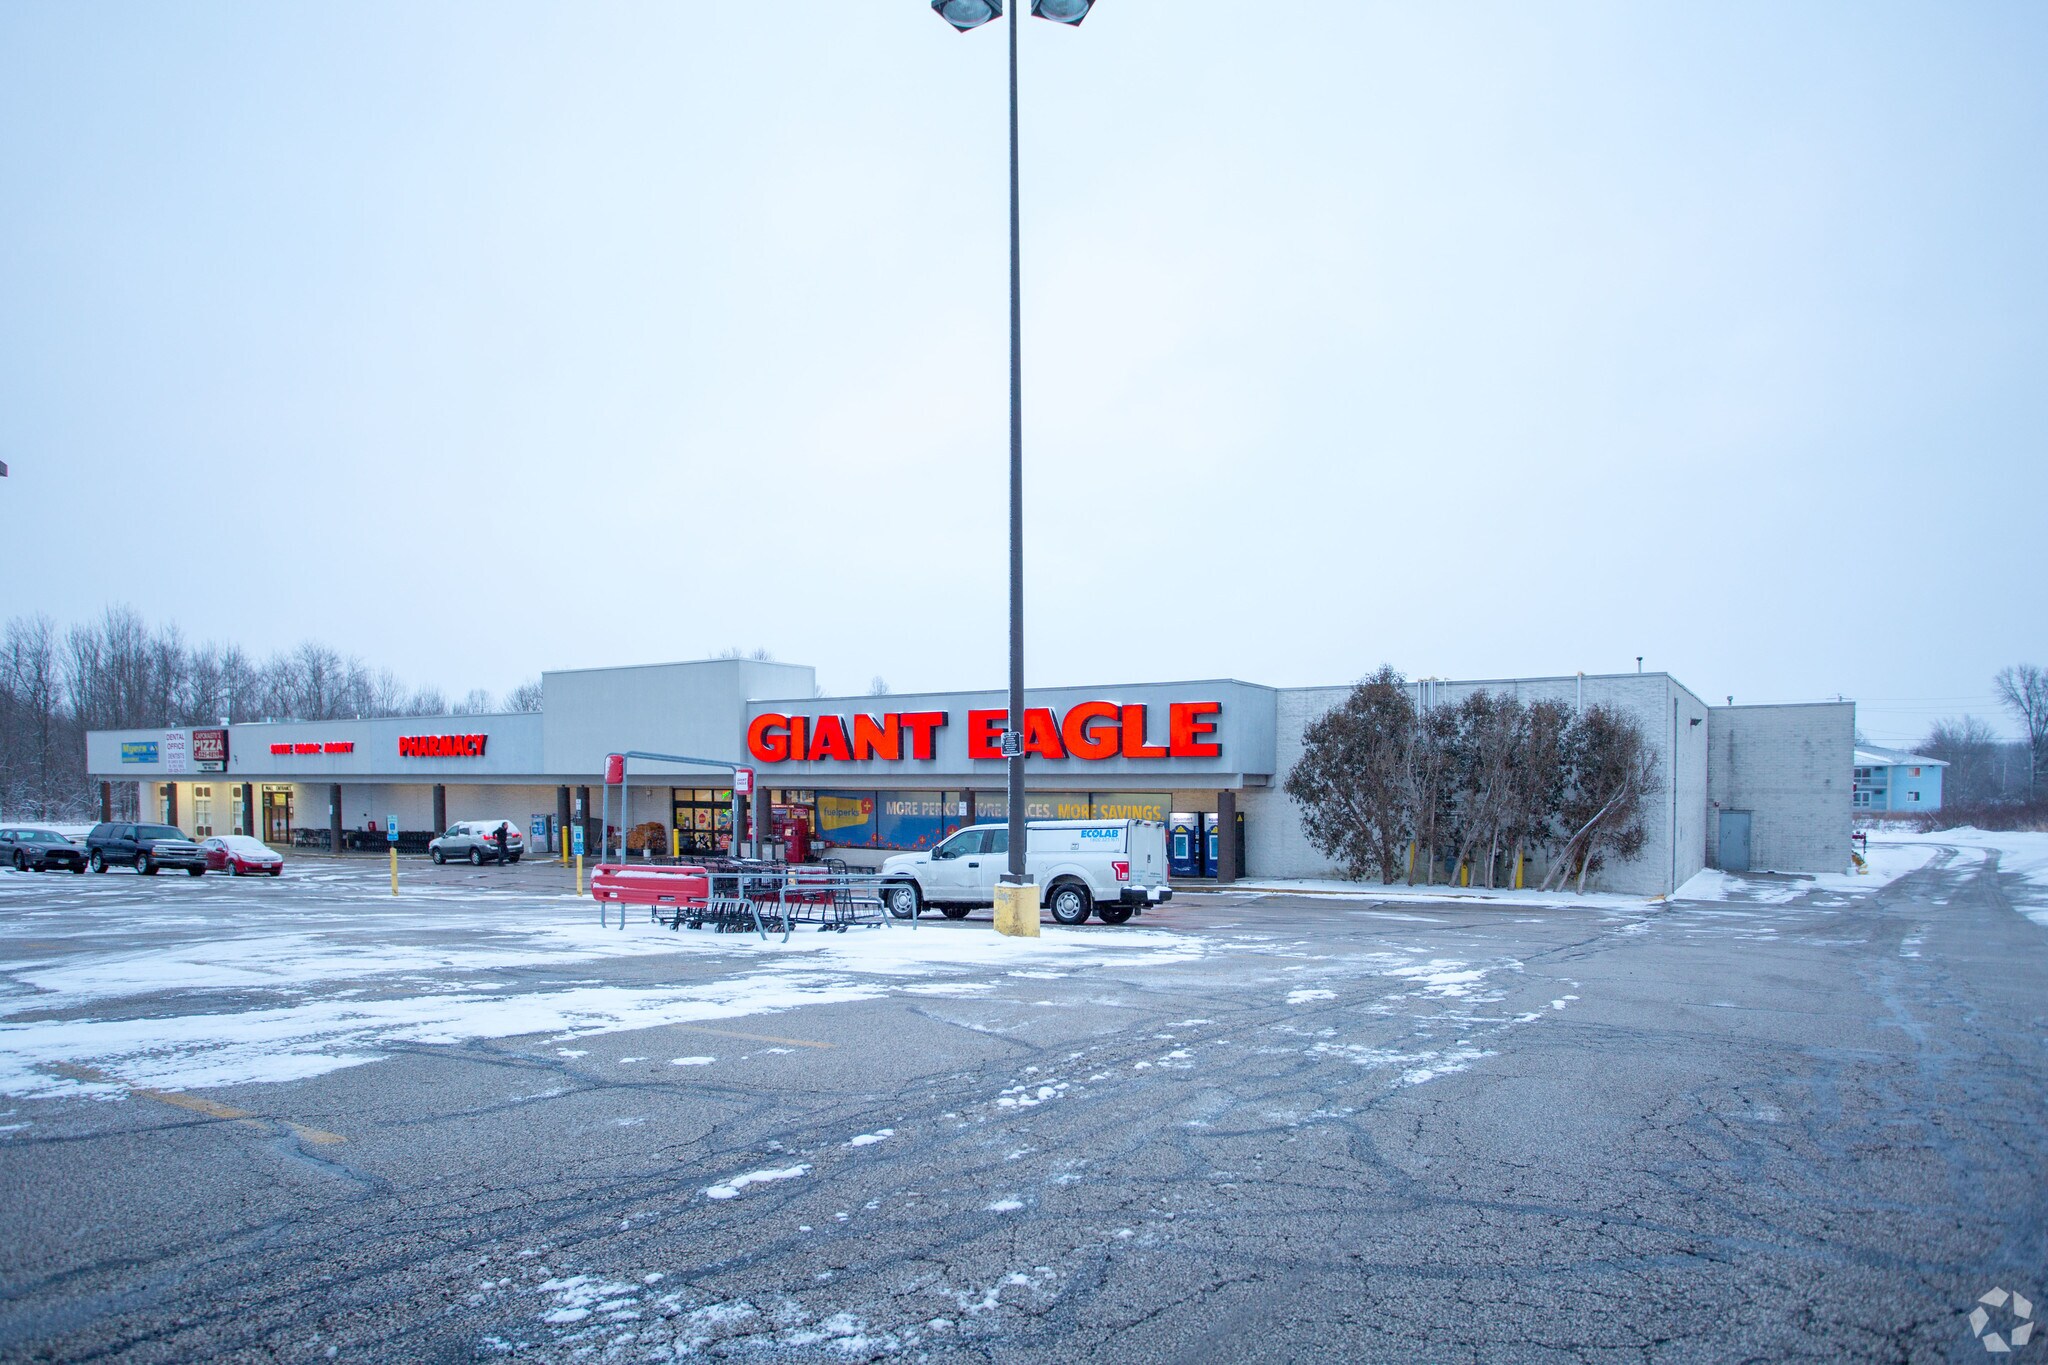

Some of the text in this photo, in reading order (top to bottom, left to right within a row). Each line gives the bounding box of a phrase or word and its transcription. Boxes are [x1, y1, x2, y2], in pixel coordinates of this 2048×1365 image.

[166, 733, 184, 741] DENTAL
[747, 700, 1223, 763] GIANT EAGLE
[194, 739, 223, 751] PIZZA
[398, 734, 488, 756] PHARMACY
[824, 807, 859, 817] fuelperks
[886, 801, 918, 816] MORE
[1058, 803, 1097, 820] MORE
[1101, 804, 1165, 821] SAVINGS.
[1081, 829, 1119, 839] ECOLAB
